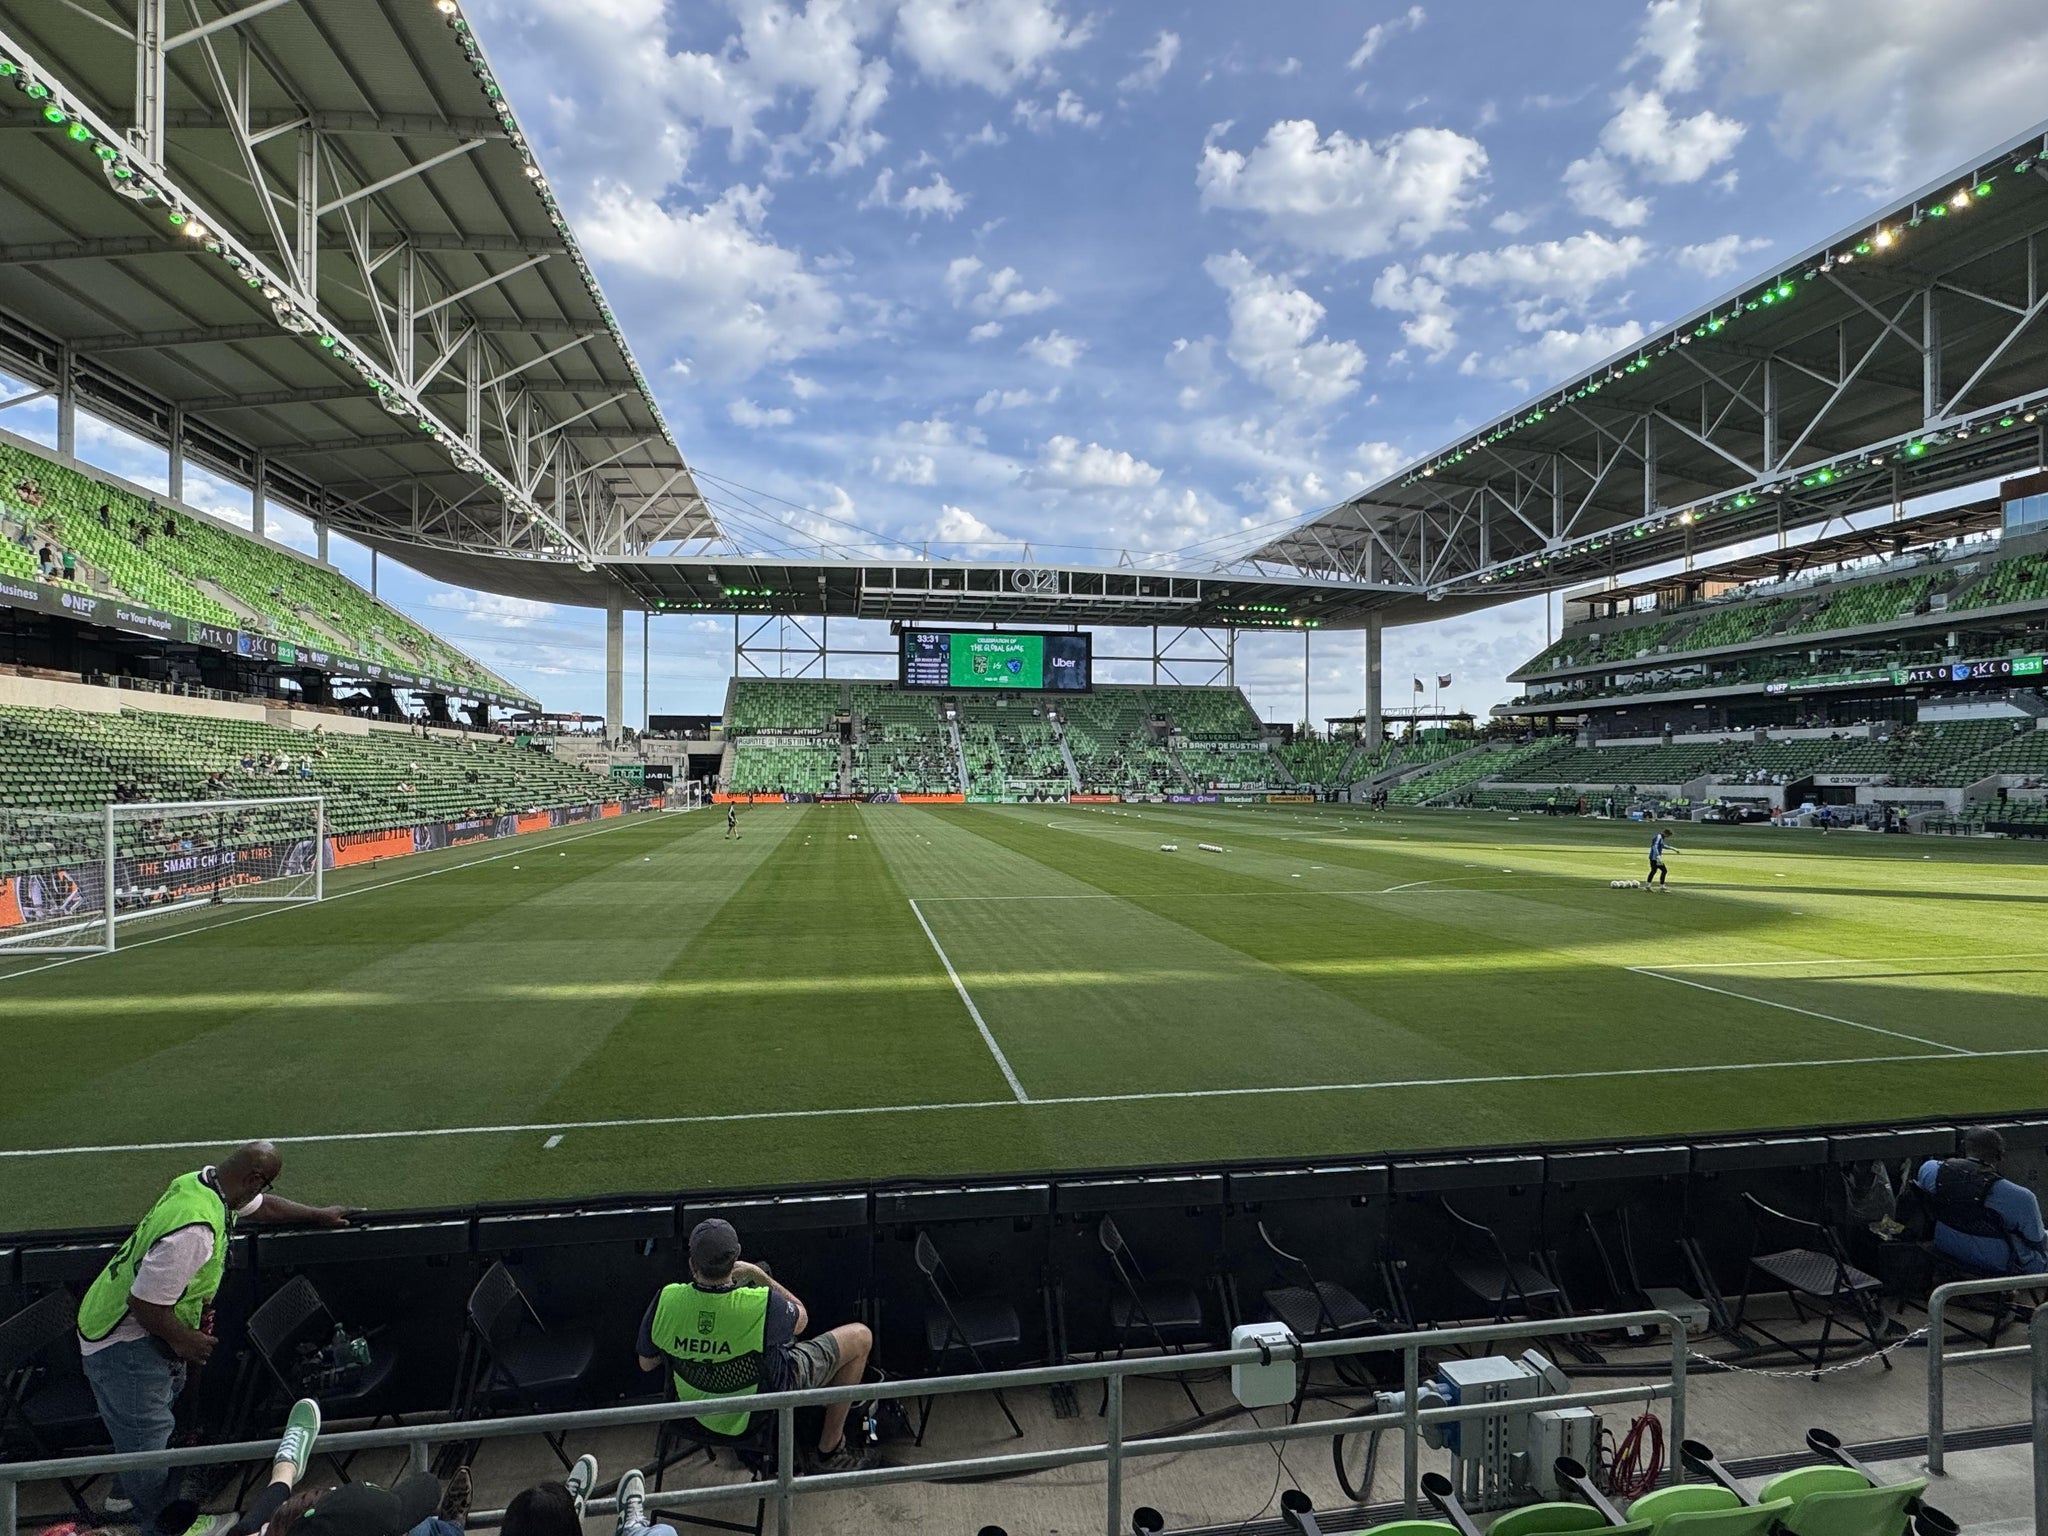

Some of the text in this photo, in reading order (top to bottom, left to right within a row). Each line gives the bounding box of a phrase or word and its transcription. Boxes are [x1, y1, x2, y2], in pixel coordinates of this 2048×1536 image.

[1011, 569, 1053, 592] Q2
[72, 596, 96, 612] NFP
[116, 609, 172, 630] For Your People
[200, 628, 223, 644] ATX
[1052, 657, 1076, 668] Uber
[2013, 661, 2040, 671] 33:31
[1909, 670, 1934, 680] ATX
[1773, 683, 1788, 691] NFP
[530, 737, 553, 745] AUSTIN
[138, 847, 273, 876] THE SMART CHICE IN TIRES
[674, 1335, 732, 1355] MEDIA
